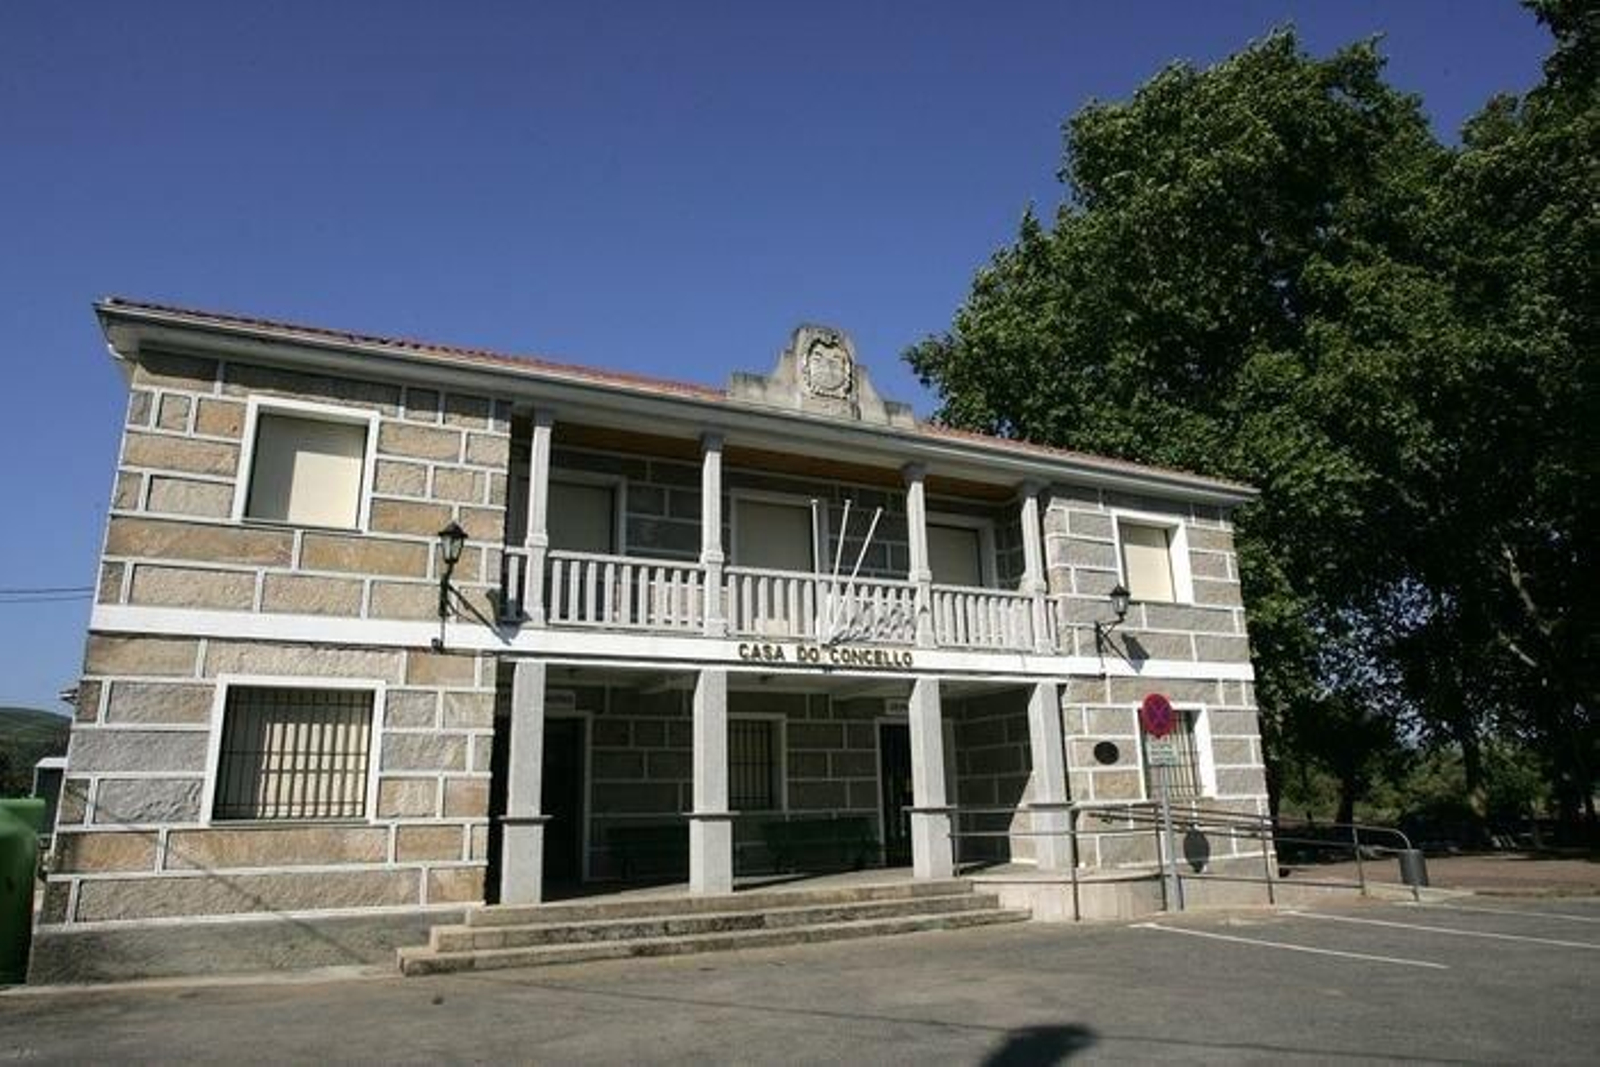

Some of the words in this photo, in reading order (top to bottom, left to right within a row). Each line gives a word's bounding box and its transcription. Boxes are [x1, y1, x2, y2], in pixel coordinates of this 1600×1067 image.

[738, 643, 785, 661] CASA
[797, 646, 820, 663] DO
[830, 649, 912, 667] CONCELLO
